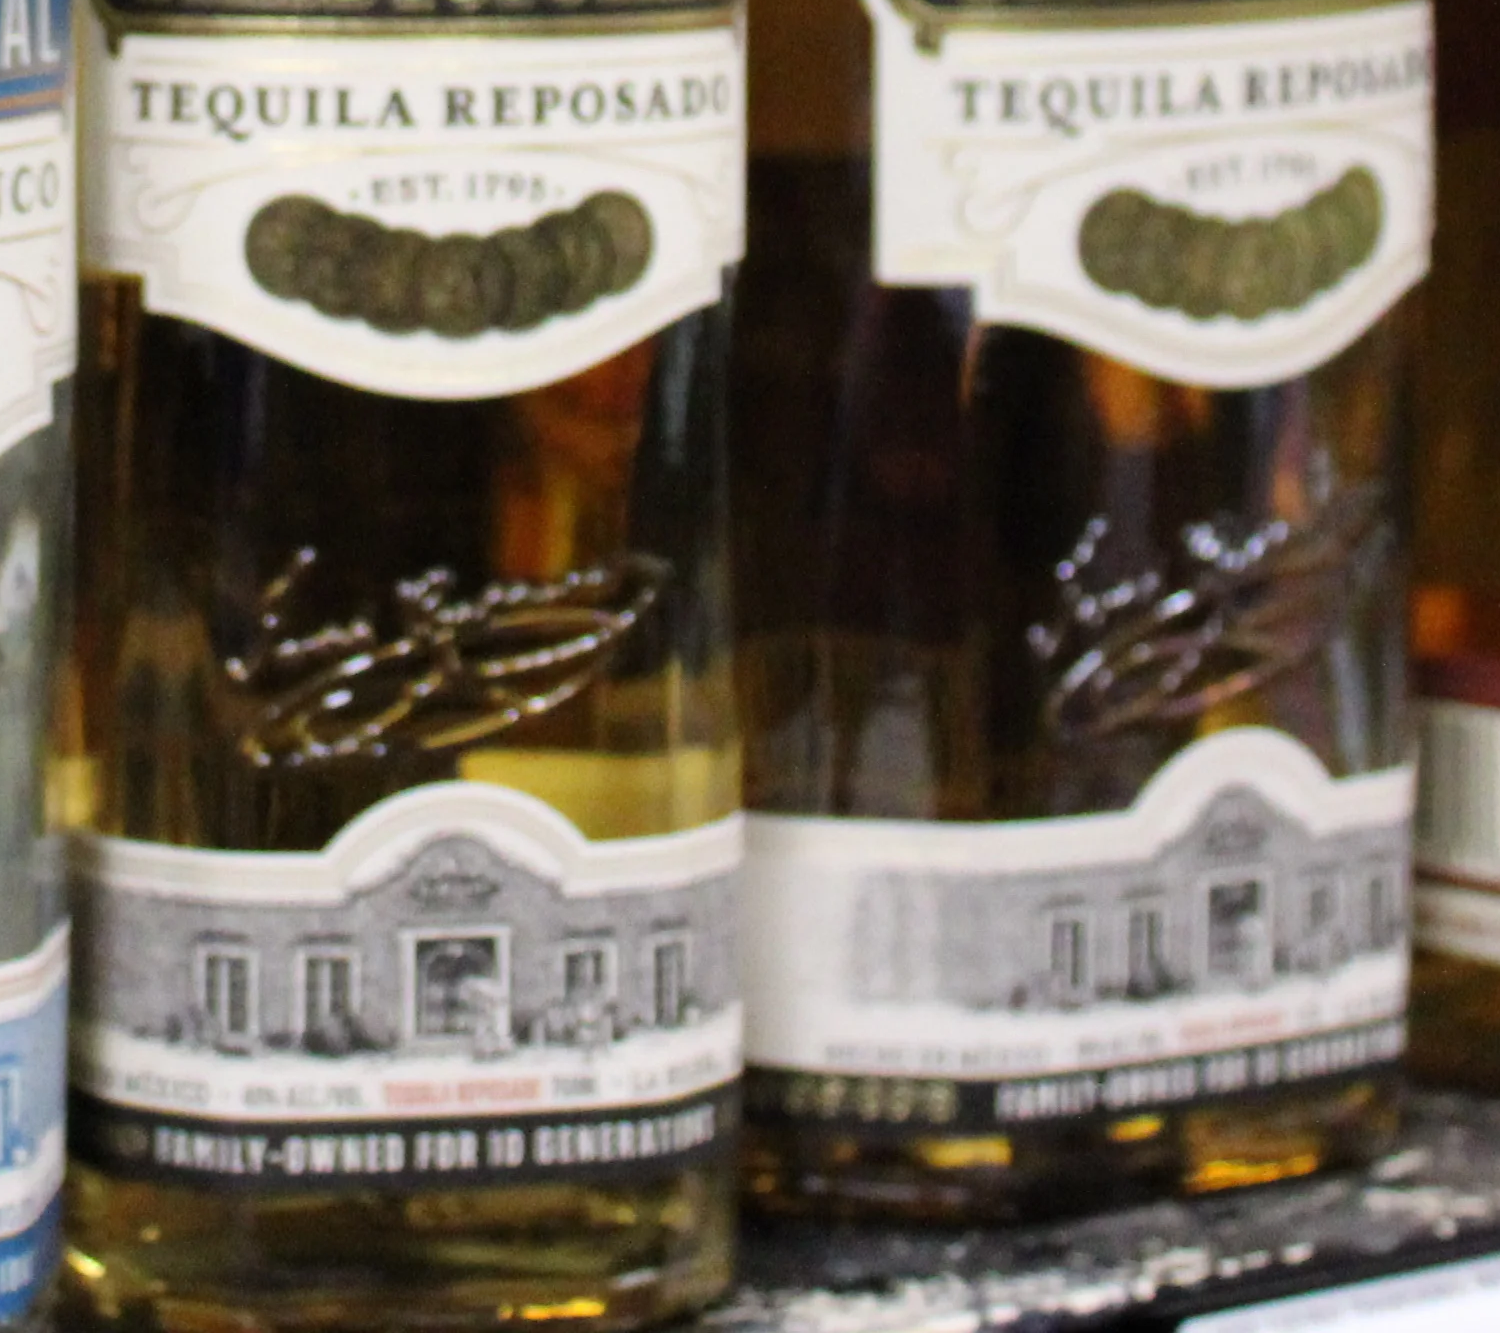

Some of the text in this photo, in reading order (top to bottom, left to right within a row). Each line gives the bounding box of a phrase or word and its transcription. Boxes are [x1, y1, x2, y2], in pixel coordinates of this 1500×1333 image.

[128, 73, 732, 140] TEQUILA REPOSADO
[953, 71, 1224, 137] TEQUILA
[414, 1129, 480, 1173] FOR
